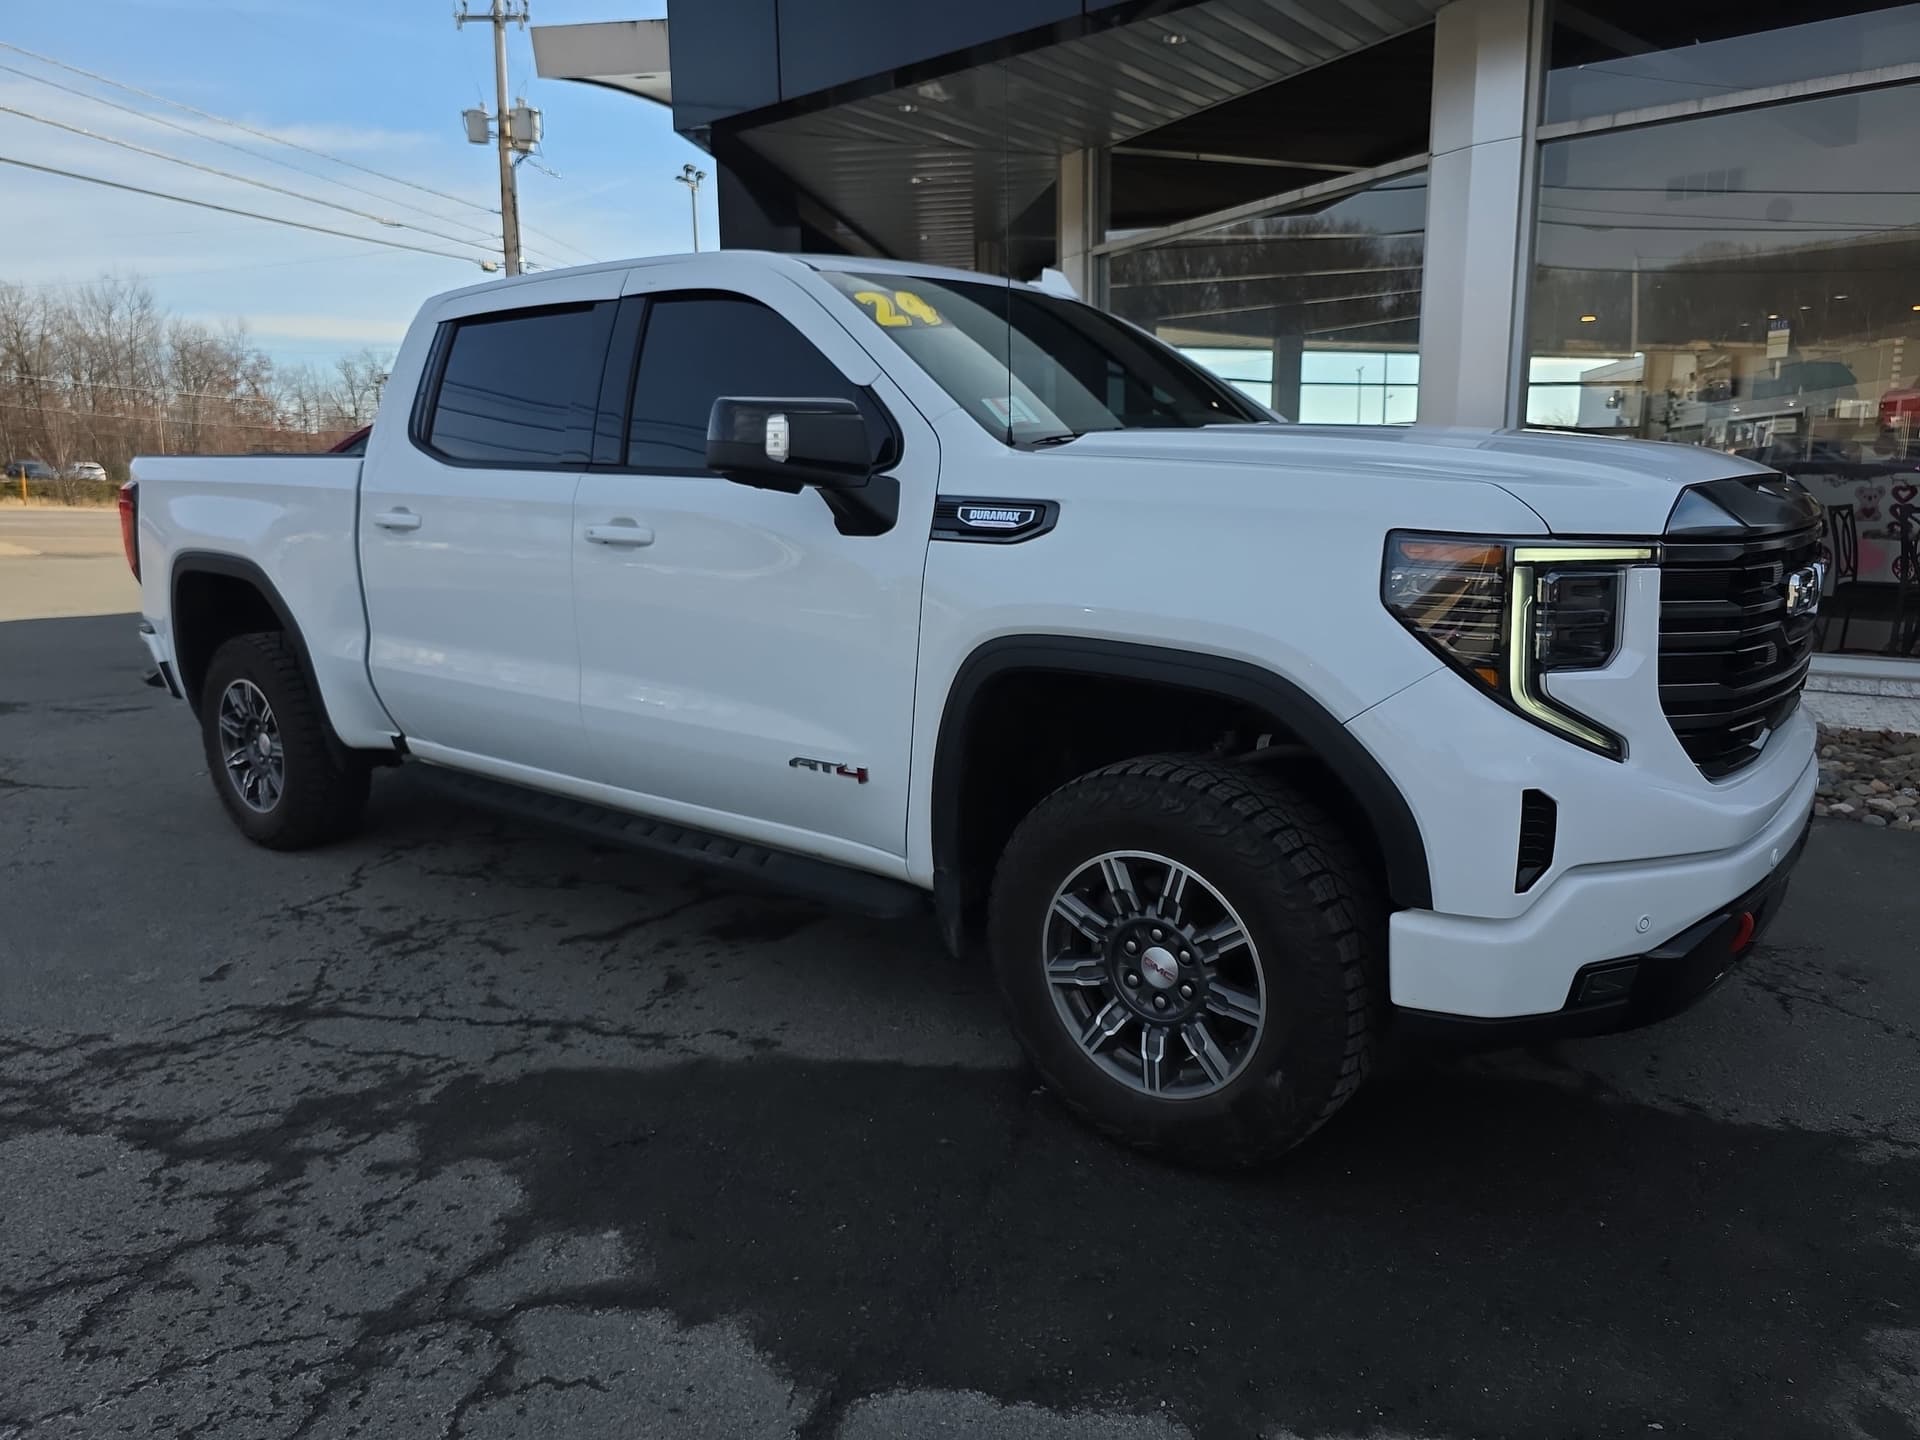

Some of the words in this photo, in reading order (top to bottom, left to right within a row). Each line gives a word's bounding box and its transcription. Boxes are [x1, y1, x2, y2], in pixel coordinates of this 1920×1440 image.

[969, 509, 1020, 521] DURAMAX
[789, 757, 868, 784] AT4
[1144, 957, 1176, 983] GMC
